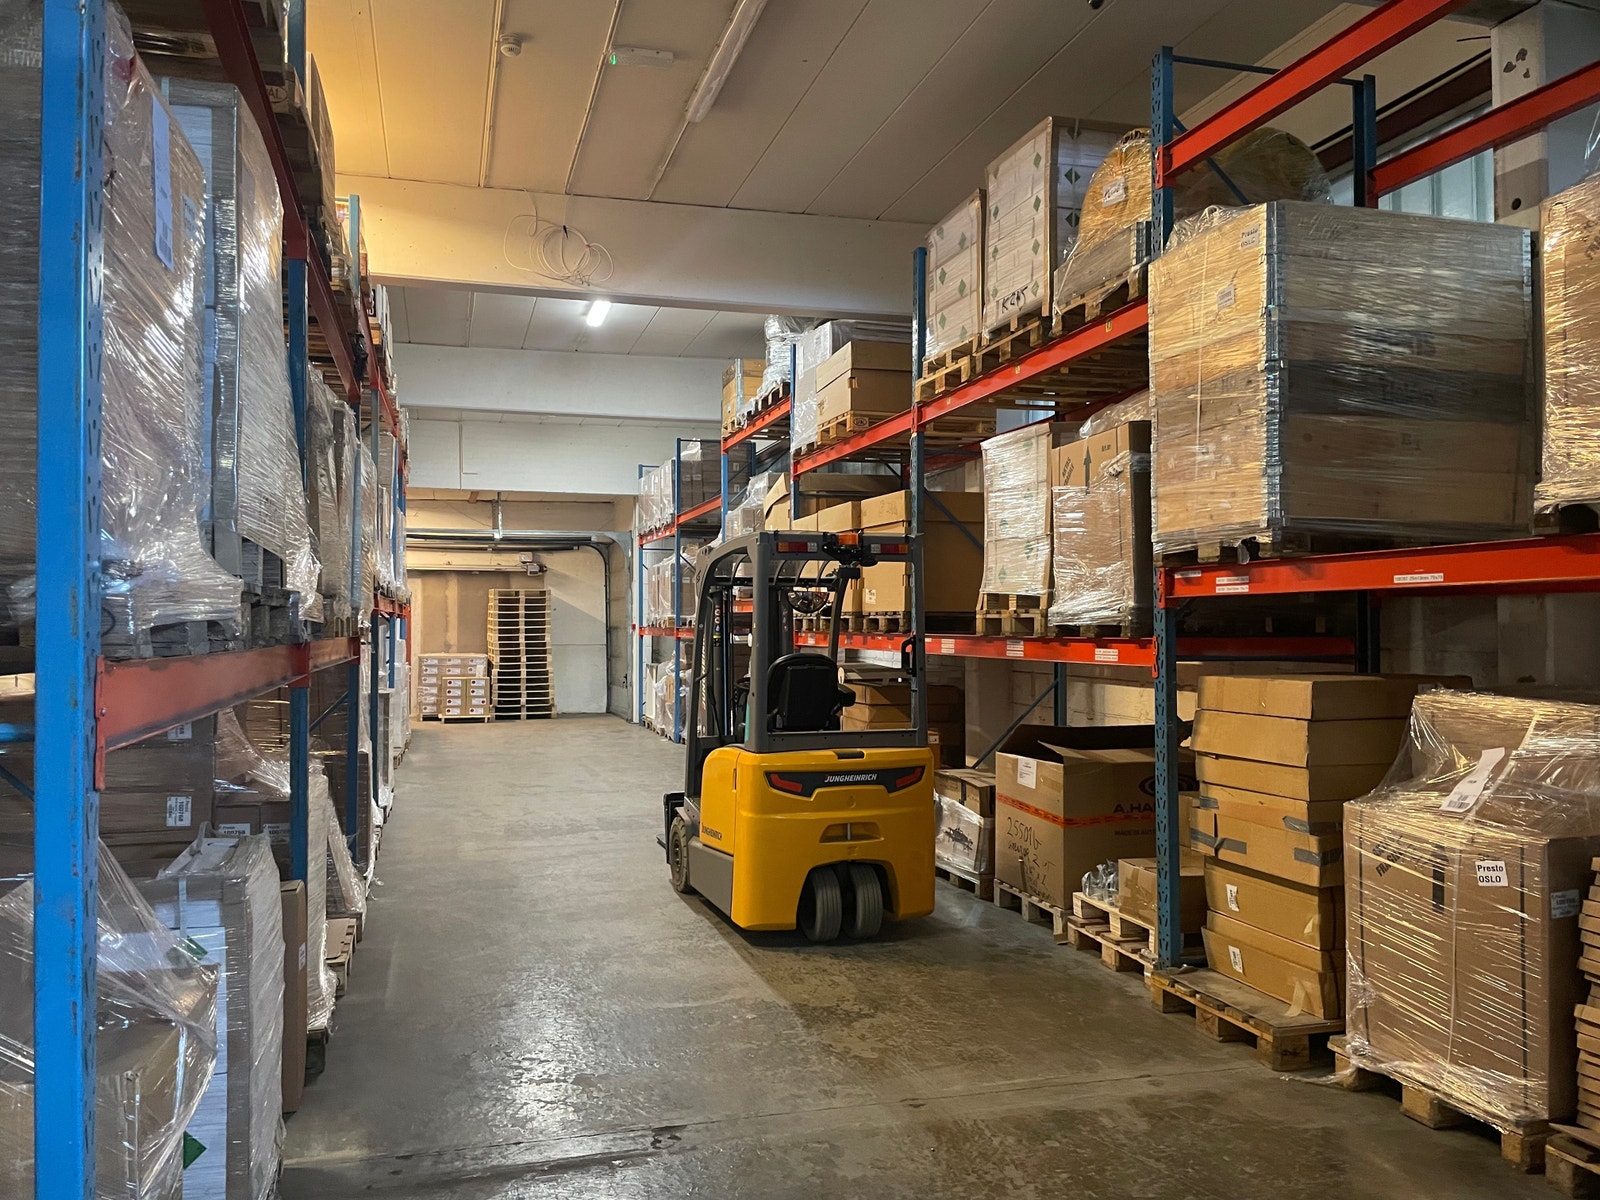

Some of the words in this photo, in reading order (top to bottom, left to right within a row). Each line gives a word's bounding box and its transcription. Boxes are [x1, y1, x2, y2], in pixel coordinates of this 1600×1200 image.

[824, 773, 878, 783] JUNGHEINRICH
[1113, 803, 1155, 813] A.HA
[1477, 864, 1504, 872] Presto
[1478, 875, 1502, 883] OSLO
